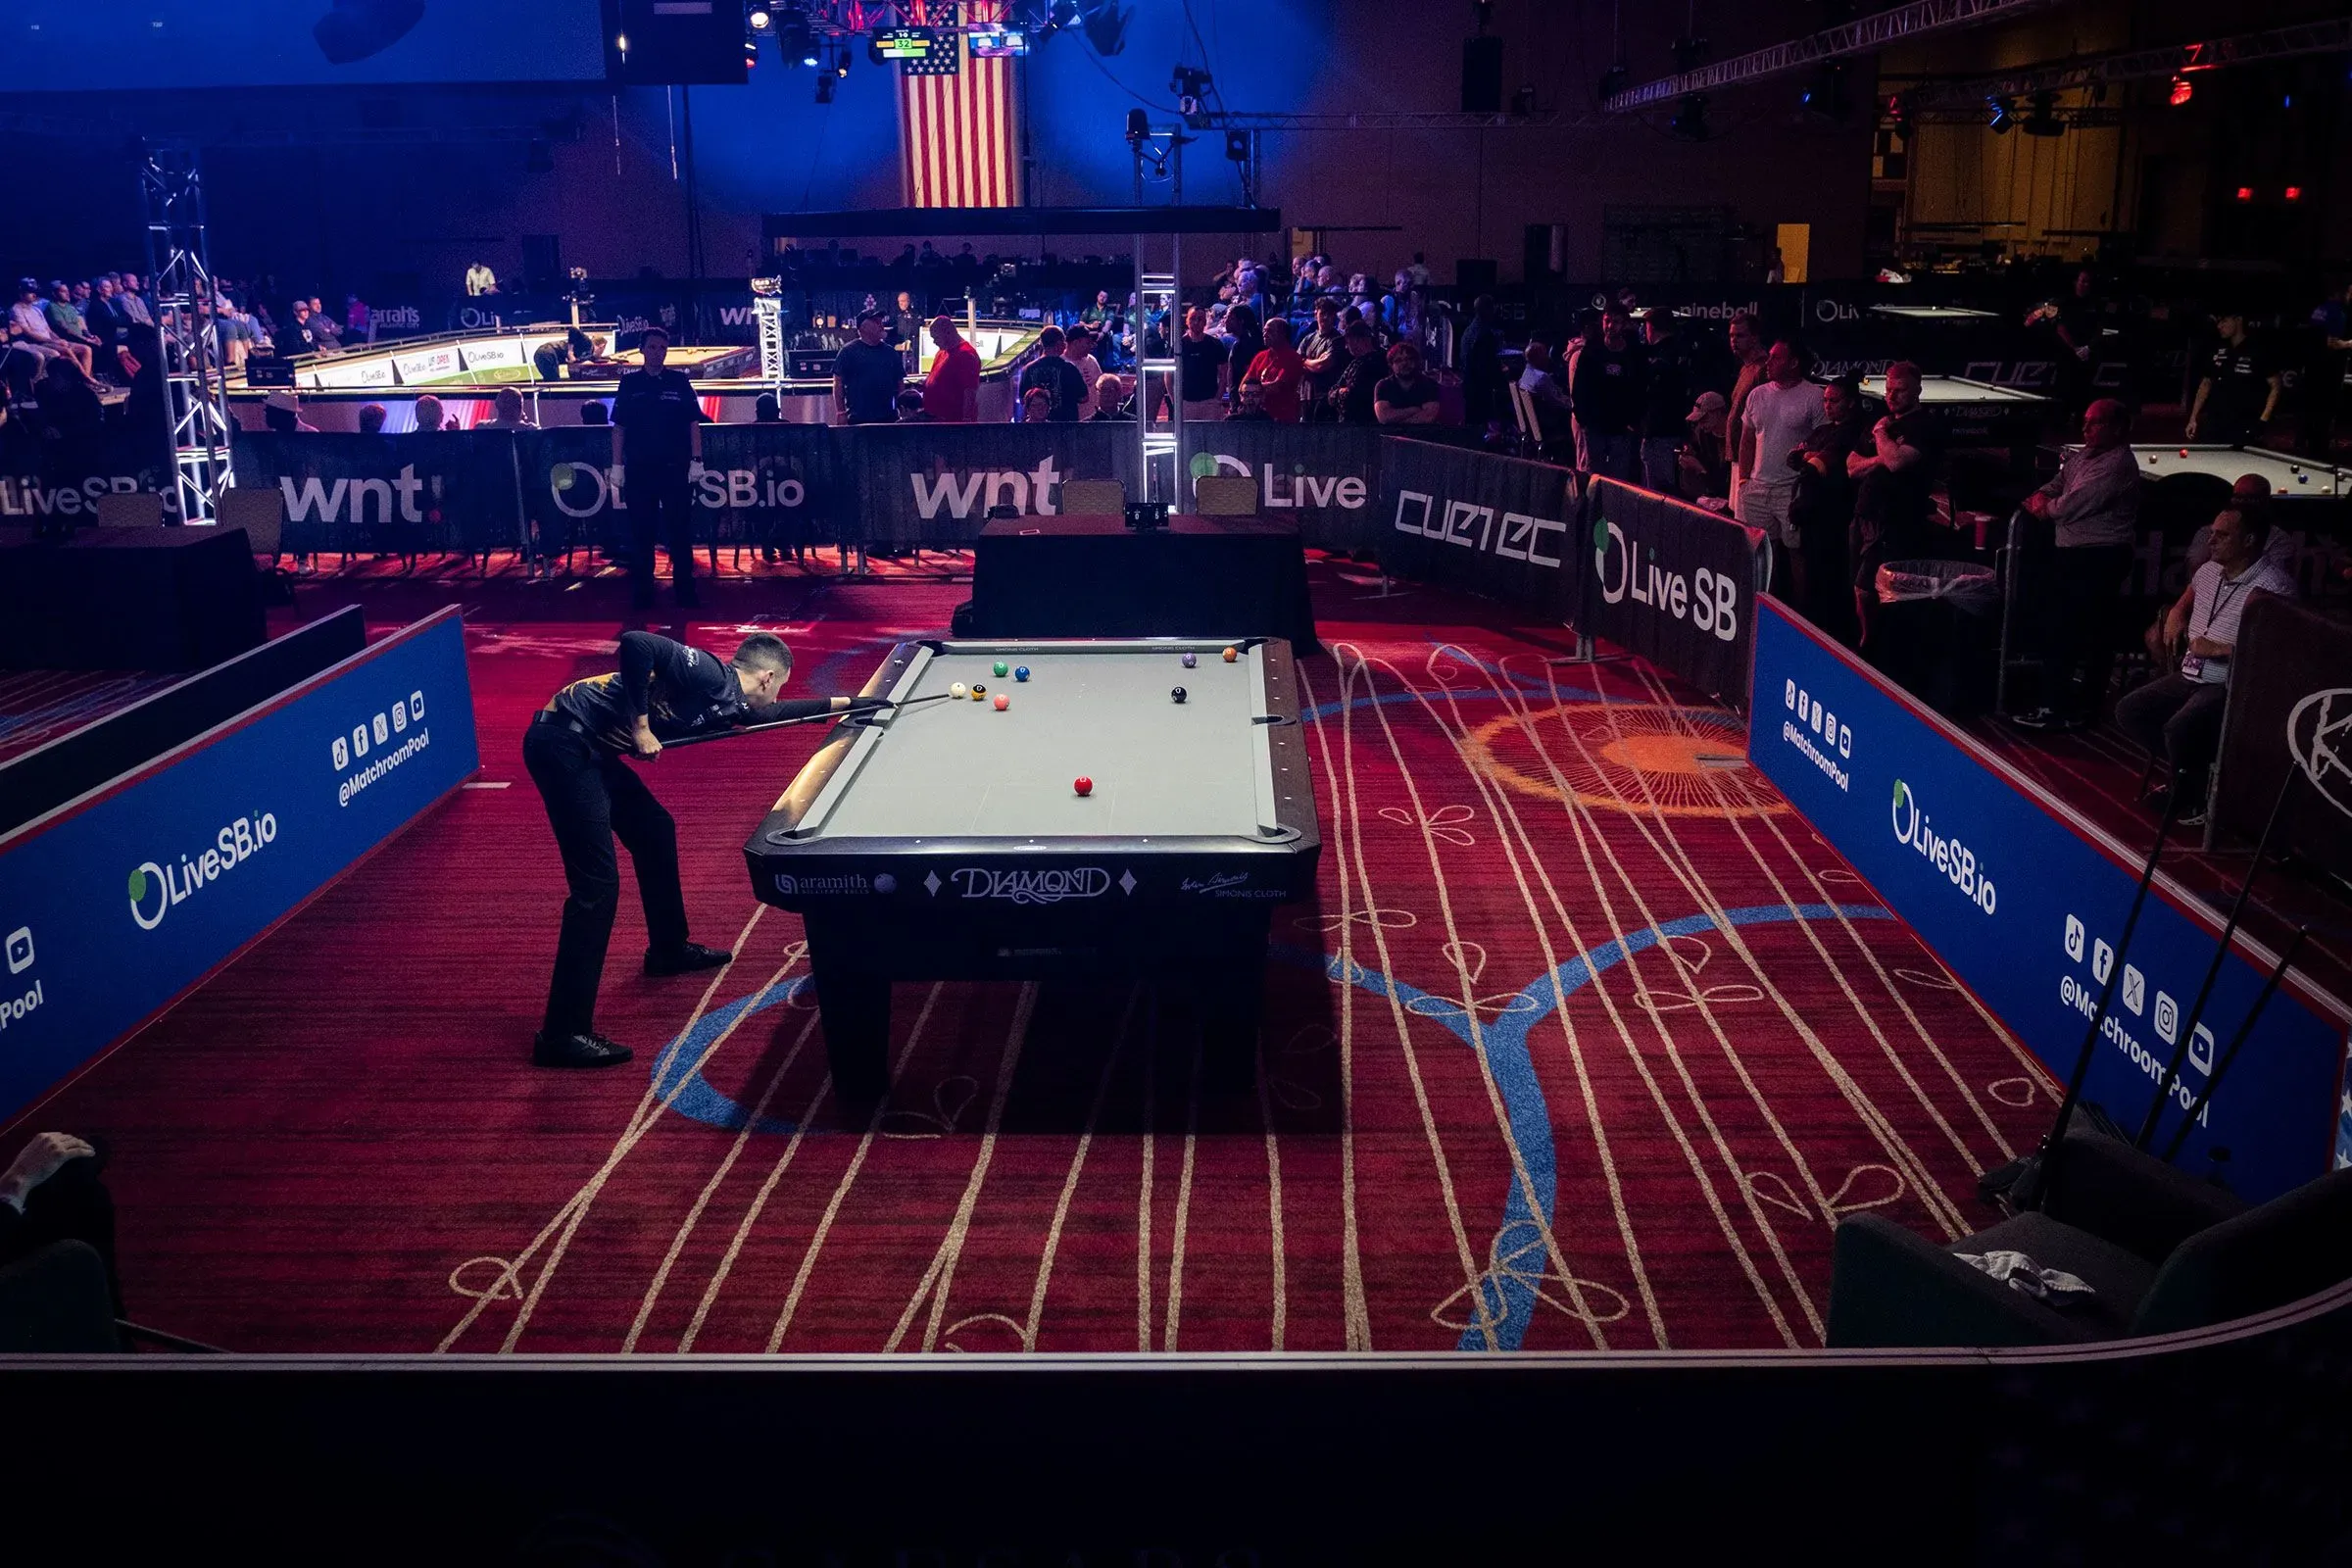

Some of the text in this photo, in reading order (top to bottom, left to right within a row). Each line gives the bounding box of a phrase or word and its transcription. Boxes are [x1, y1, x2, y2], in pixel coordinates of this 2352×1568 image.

[371, 306, 419, 323] arrah's
[338, 727, 429, 808] @MatchroomPool
[1783, 720, 1848, 792] @MatchroomPool
[800, 873, 868, 889] aramith
[951, 867, 1110, 905] DIAMOND
[1215, 889, 1287, 898] SIMONIS CLOTH
[0, 980, 43, 1032] Pool
